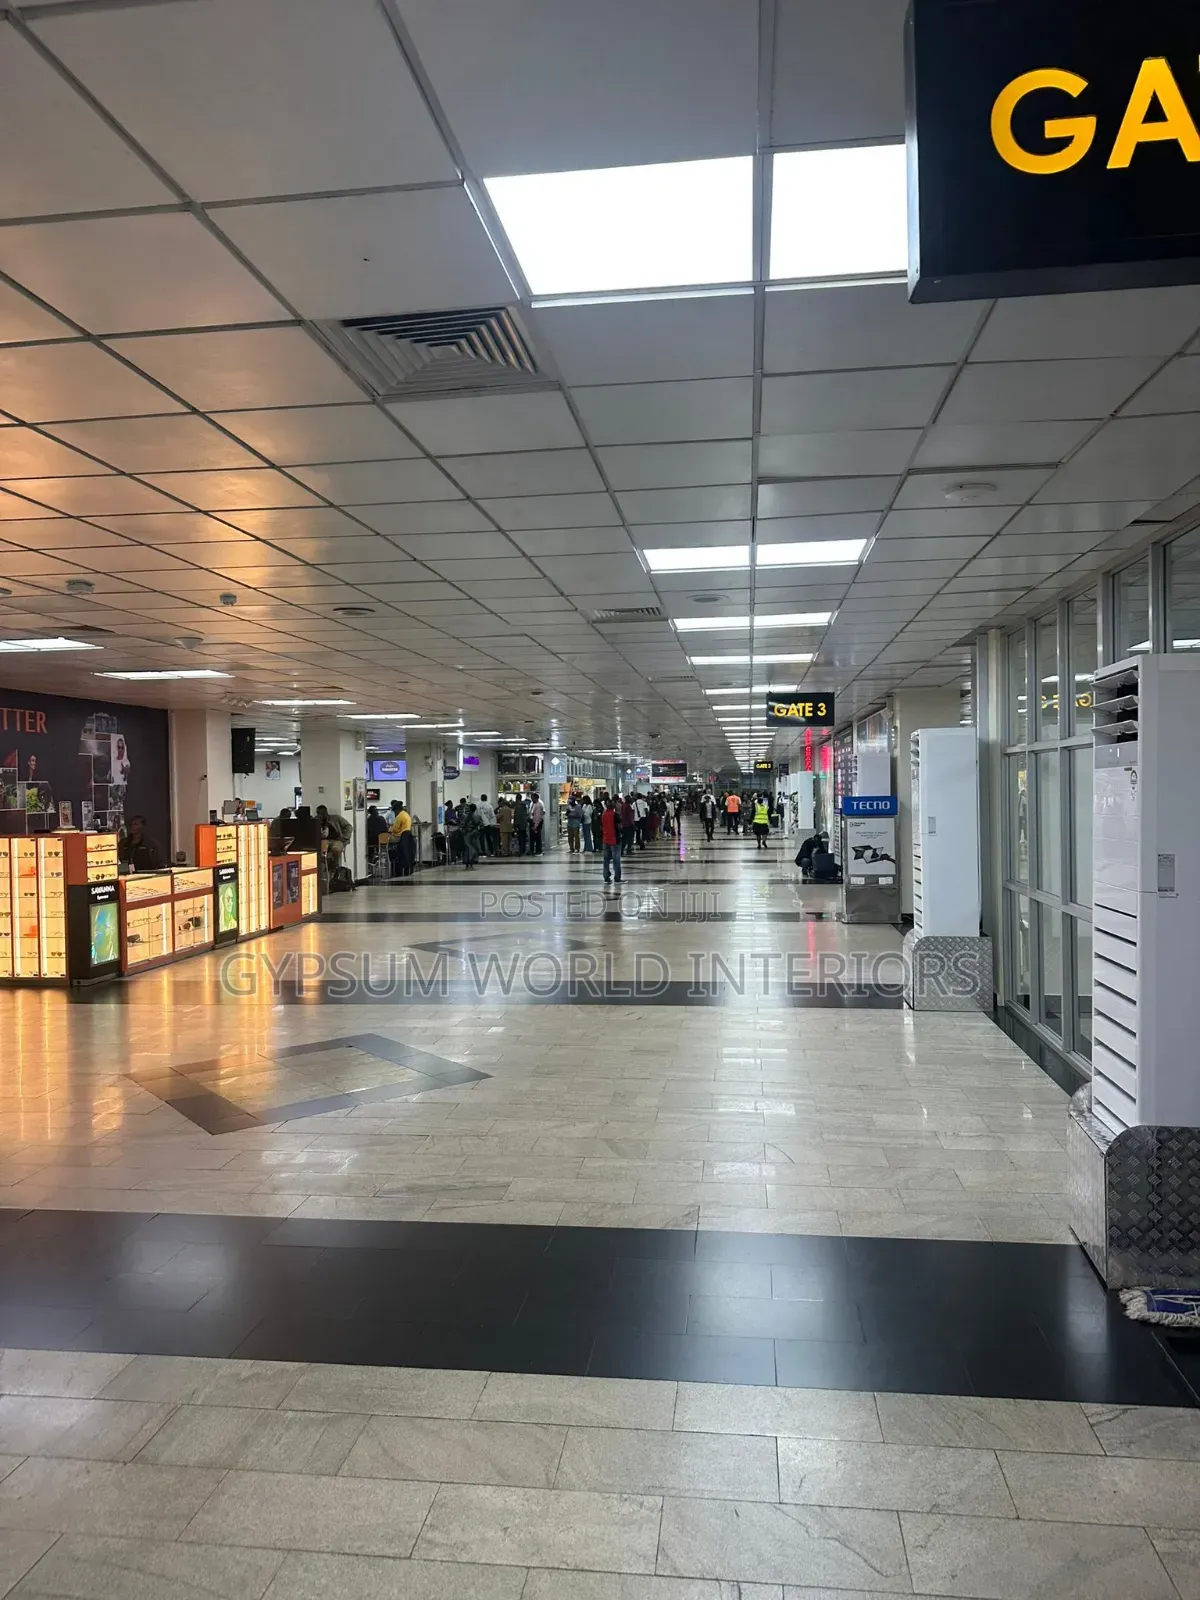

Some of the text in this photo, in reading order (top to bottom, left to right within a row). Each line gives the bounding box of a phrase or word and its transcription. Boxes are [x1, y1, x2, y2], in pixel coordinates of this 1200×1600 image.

[990, 55, 1200, 175] GA
[773, 702, 827, 717] GATE 3
[851, 800, 891, 810] TECNO
